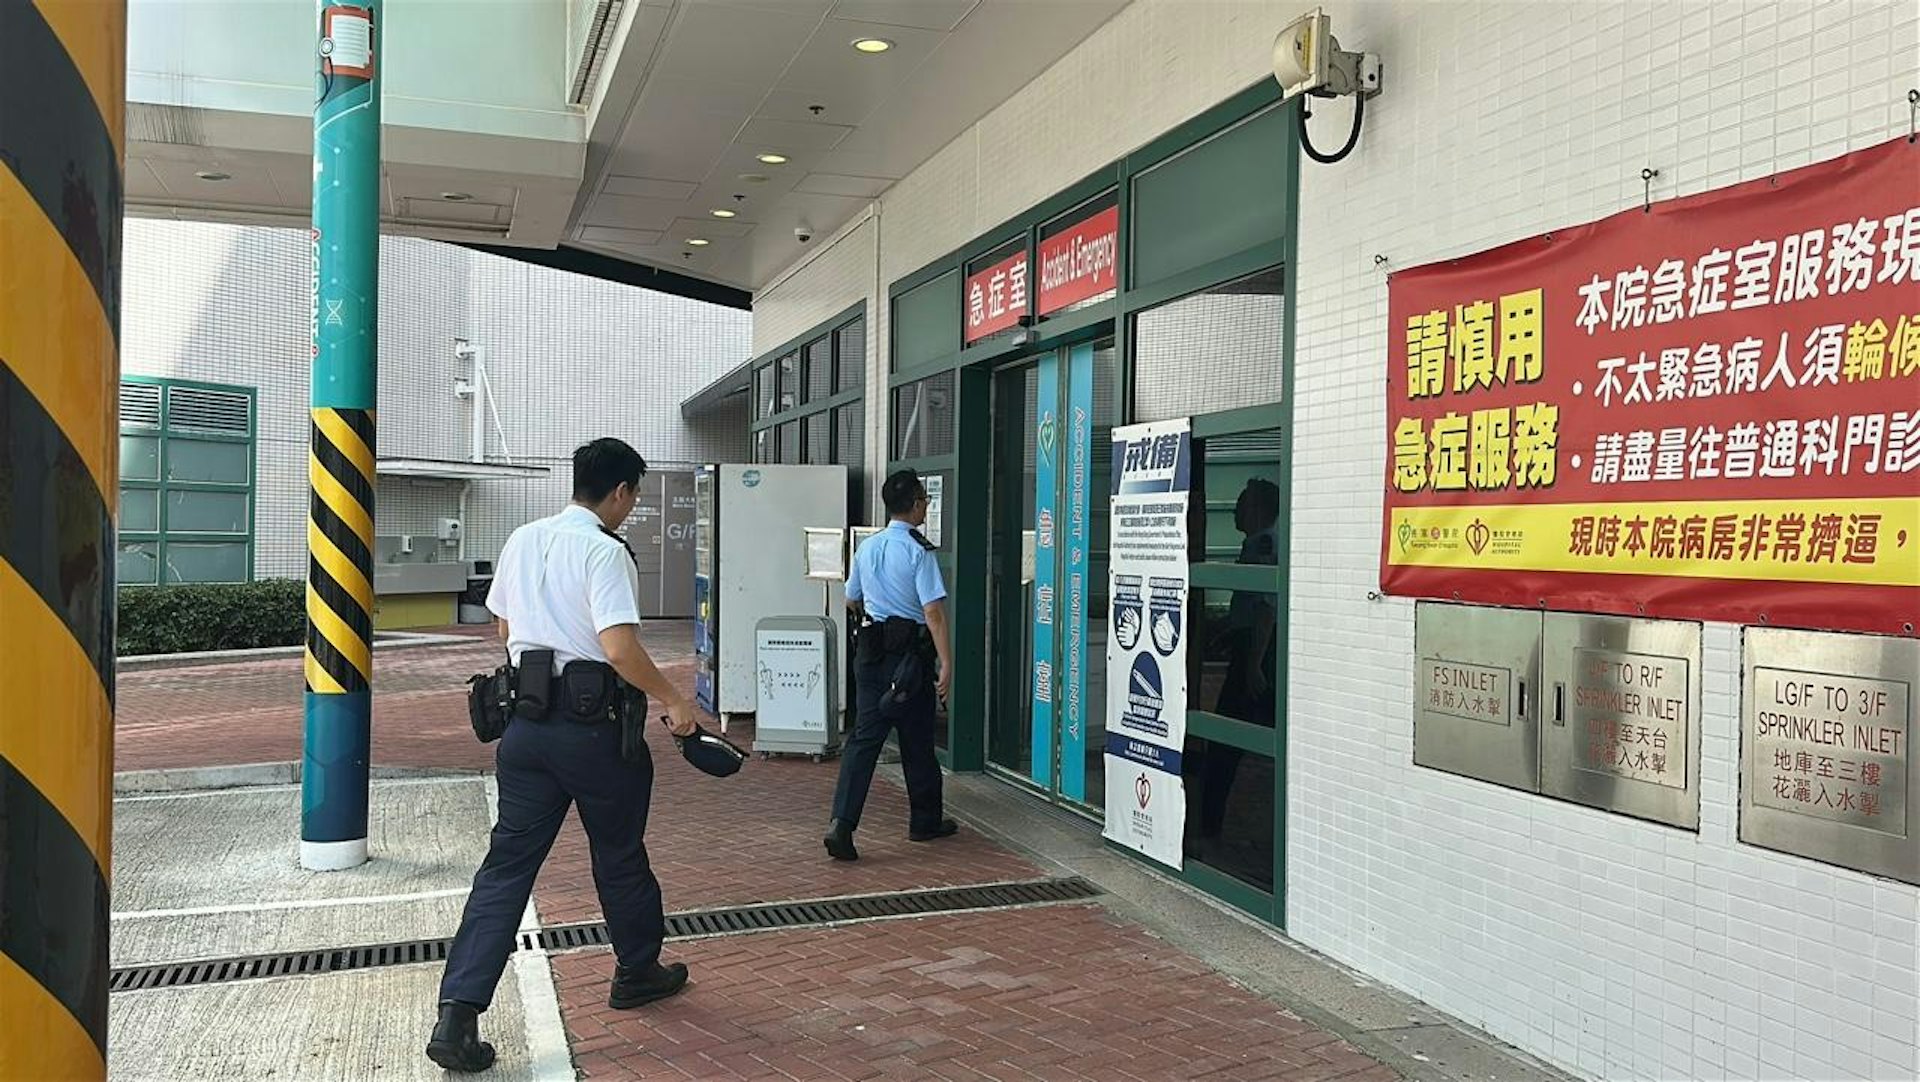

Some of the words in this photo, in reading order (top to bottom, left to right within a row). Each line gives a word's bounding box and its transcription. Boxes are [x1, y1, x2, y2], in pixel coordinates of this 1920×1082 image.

[1042, 245, 1070, 291] Accident
[1076, 231, 1117, 284] Emergency
[1575, 207, 1920, 335] 本院急症室服務現
[969, 260, 1027, 327] 急症室
[1405, 288, 1545, 400] 請慎用
[1125, 433, 1180, 472] 戒備
[1392, 401, 1559, 493] 急症服務
[1072, 407, 1086, 540] ACCIDENT
[1072, 549, 1082, 566] &
[1069, 572, 1081, 740] EMERGENCY
[1616, 663, 1633, 684] TO
[1641, 665, 1663, 688] R/F
[1433, 666, 1450, 685] FS
[1454, 668, 1498, 692] INLET
[1774, 680, 1814, 706] LG/F
[1824, 686, 1849, 712] TO
[1859, 690, 1888, 717] 3/F
[1576, 686, 1641, 716] SPRINKLER
[1647, 696, 1682, 721] INLET
[1758, 712, 1844, 748] SPRINKLER
[1852, 724, 1902, 755] INLET
[1773, 747, 1882, 788] 地庫至三樓
